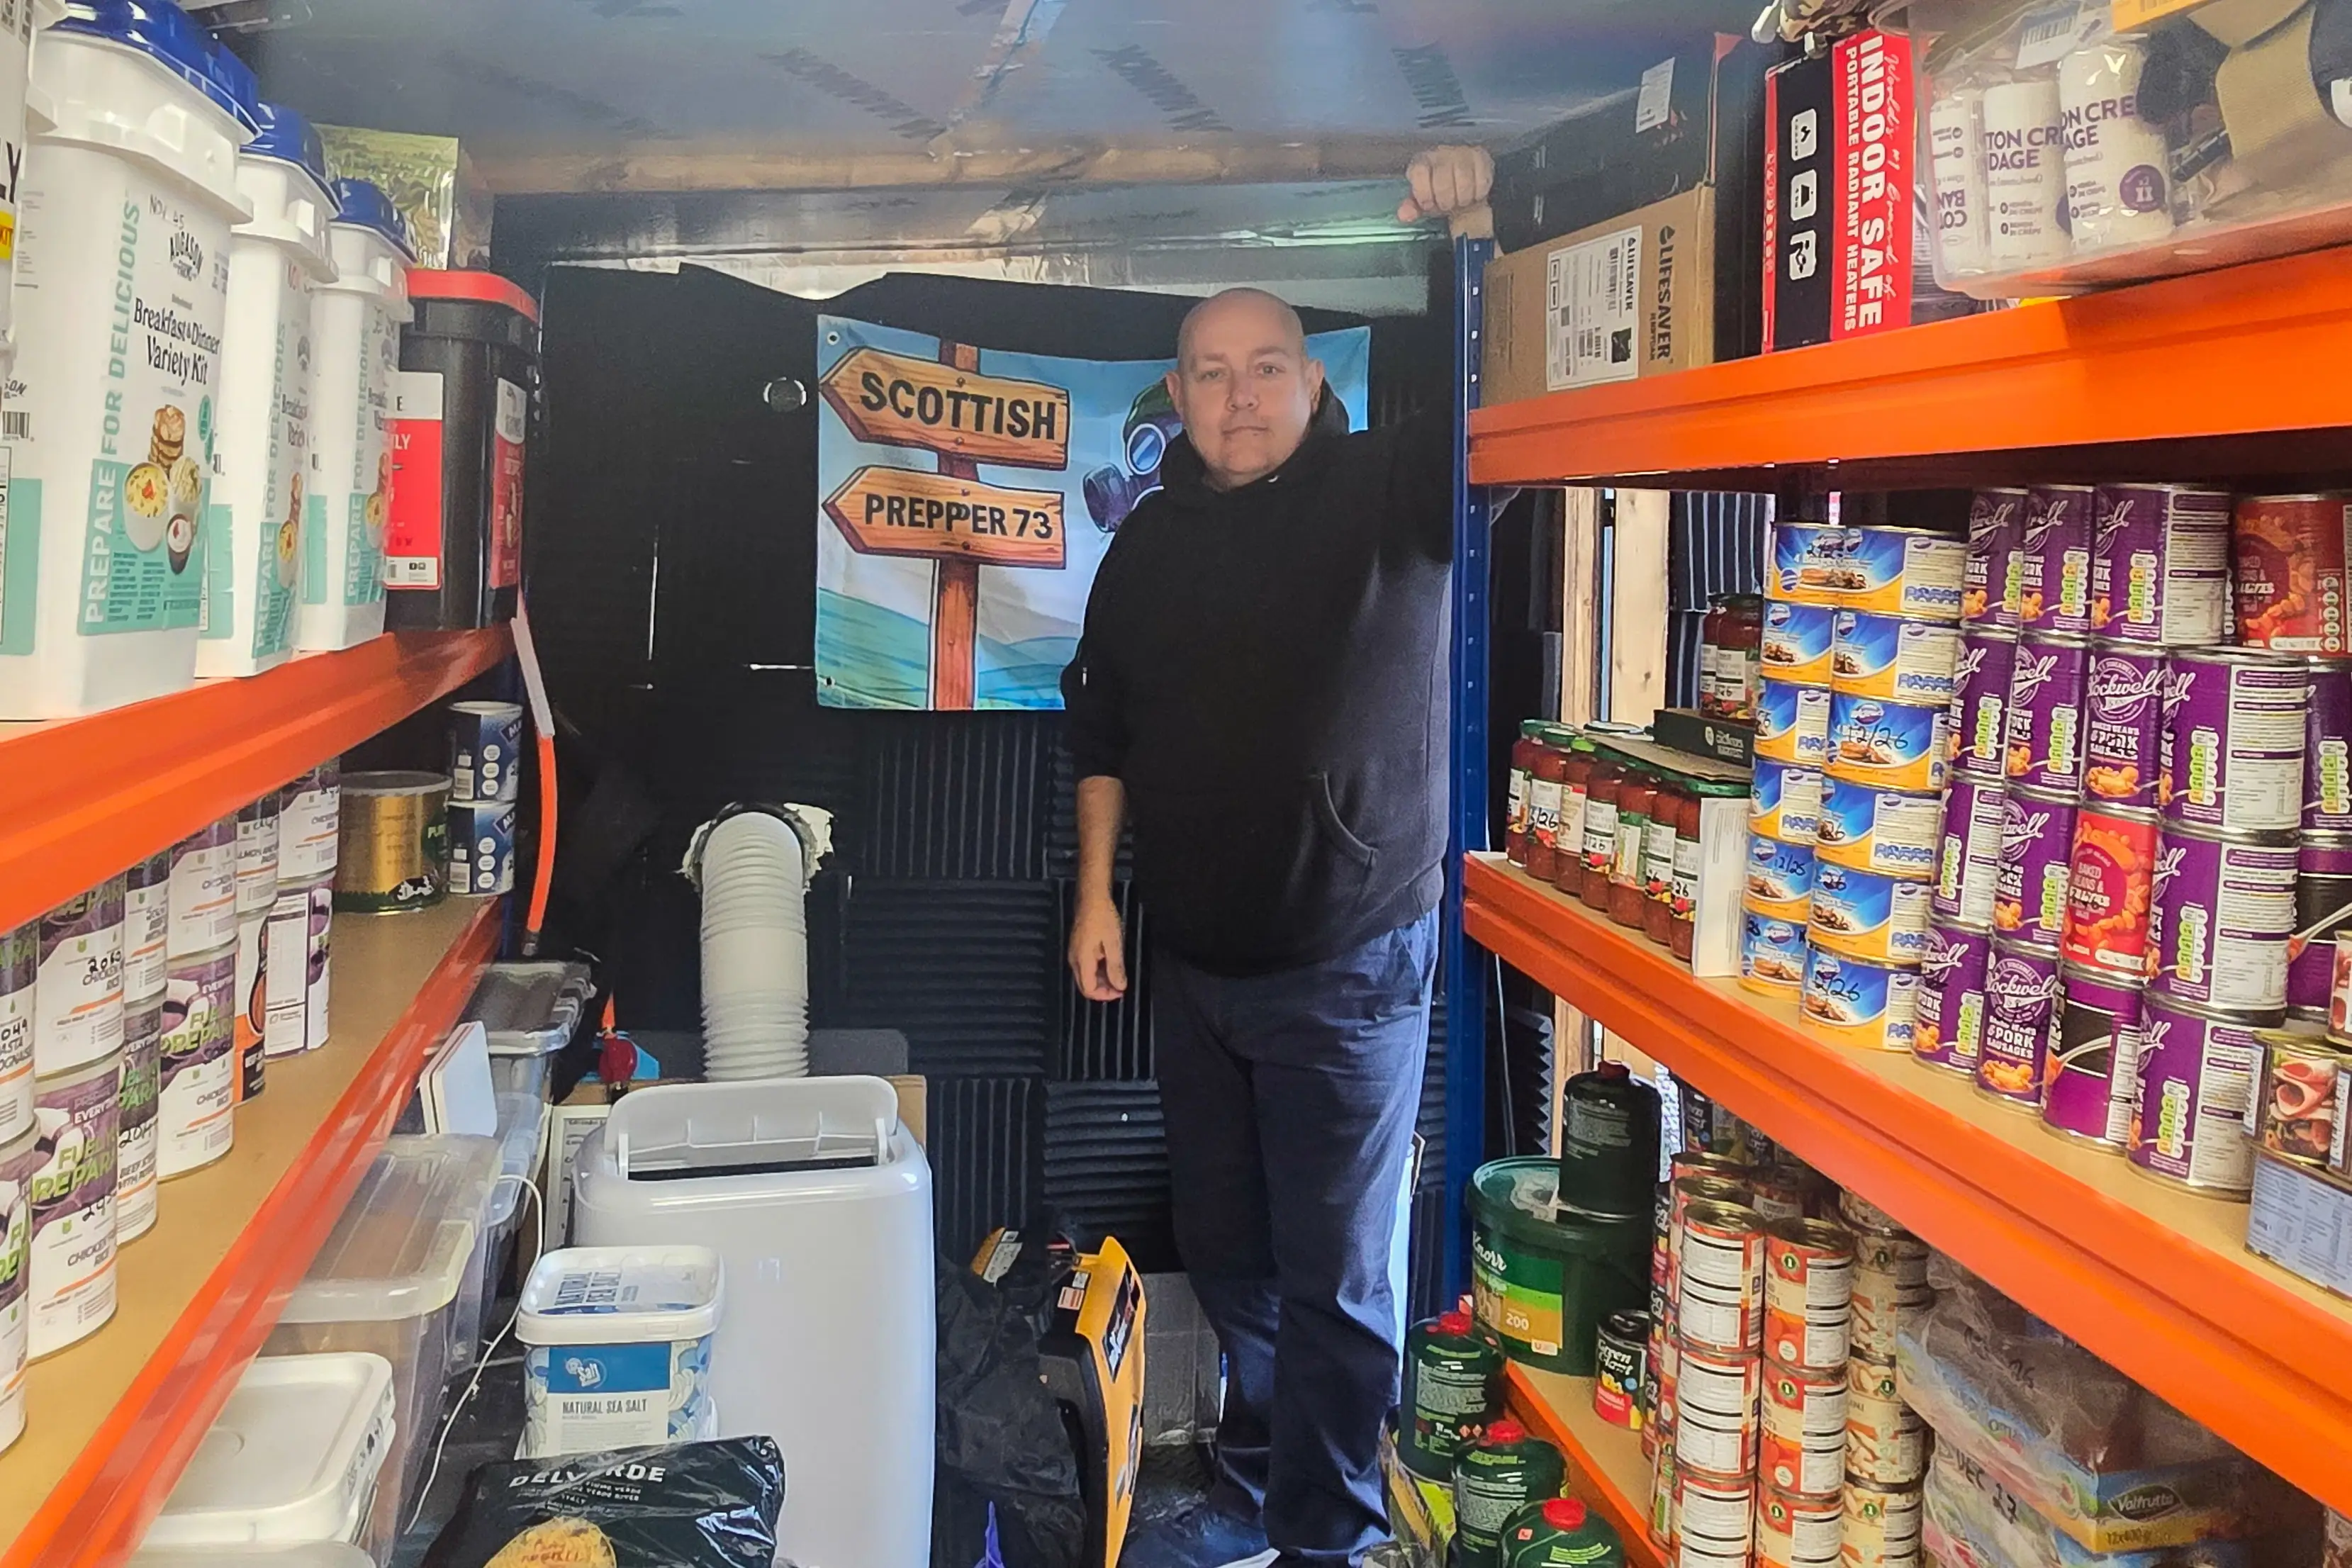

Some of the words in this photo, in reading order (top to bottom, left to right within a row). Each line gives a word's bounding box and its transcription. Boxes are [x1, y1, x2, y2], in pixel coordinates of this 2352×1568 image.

[1846, 45, 1859, 147] PORTABLE
[1861, 35, 1886, 202] INDOOR
[1847, 151, 1860, 237] RADIANT
[108, 200, 140, 379] DELICIOUS
[1657, 246, 1674, 359] LIFESAVER
[1844, 247, 1859, 332] HEATERS
[1859, 216, 1885, 327] SAFE
[133, 297, 186, 342] Breakfast
[147, 335, 191, 386] Variety
[191, 352, 208, 386] Kit
[101, 391, 123, 455] FOR
[860, 371, 1056, 439] SCOTTISH
[265, 469, 279, 518] FOR
[866, 495, 1007, 536] PREPPER
[1014, 509, 1053, 539] 73
[85, 465, 117, 623] PREPARE
[1473, 1230, 1508, 1272] Knorr
[1506, 1313, 1529, 1331] 200
[562, 1401, 603, 1415] NATURAL
[607, 1400, 622, 1413] SEA
[625, 1399, 648, 1413] SALT
[509, 1464, 667, 1488] DELVRDE
